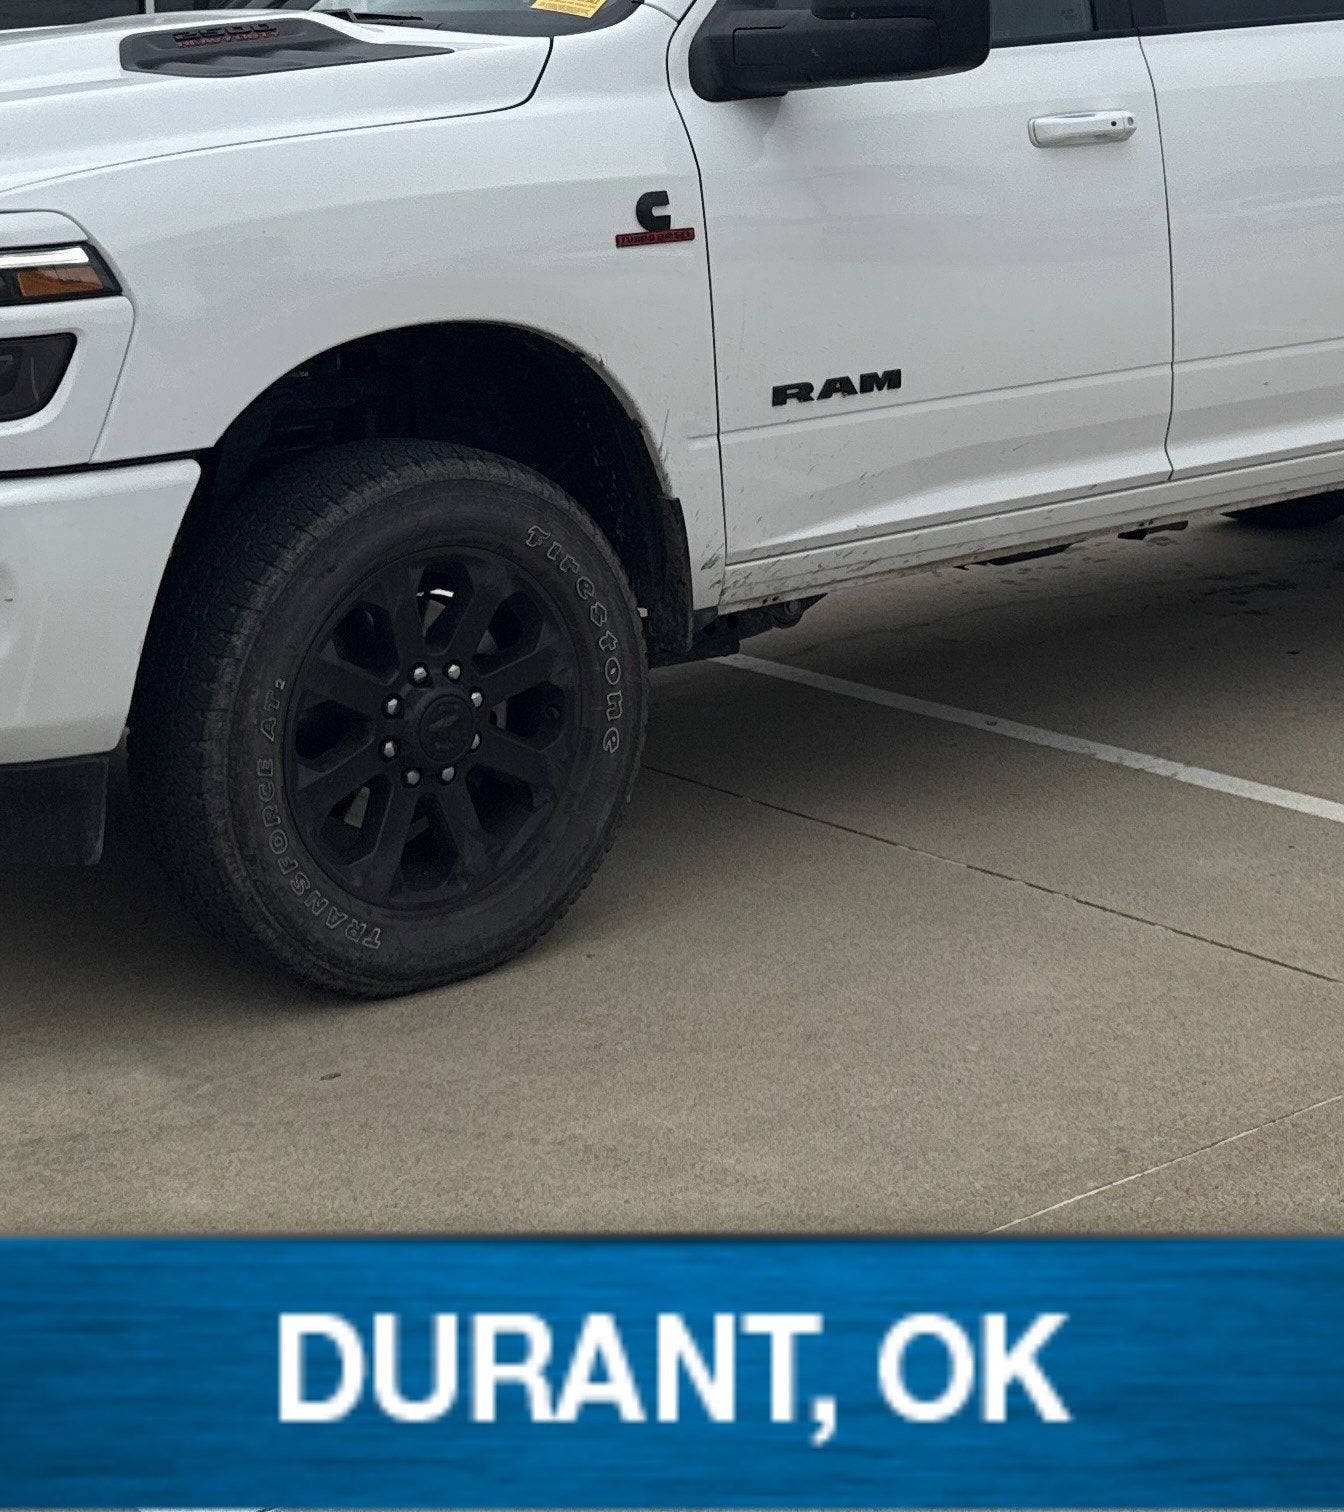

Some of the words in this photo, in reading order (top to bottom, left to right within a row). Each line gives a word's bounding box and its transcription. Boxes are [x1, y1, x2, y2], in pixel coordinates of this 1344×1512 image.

[772, 369, 902, 407] RAM
[526, 525, 623, 754] Firestone
[257, 758, 382, 951] TRANSFORCE
